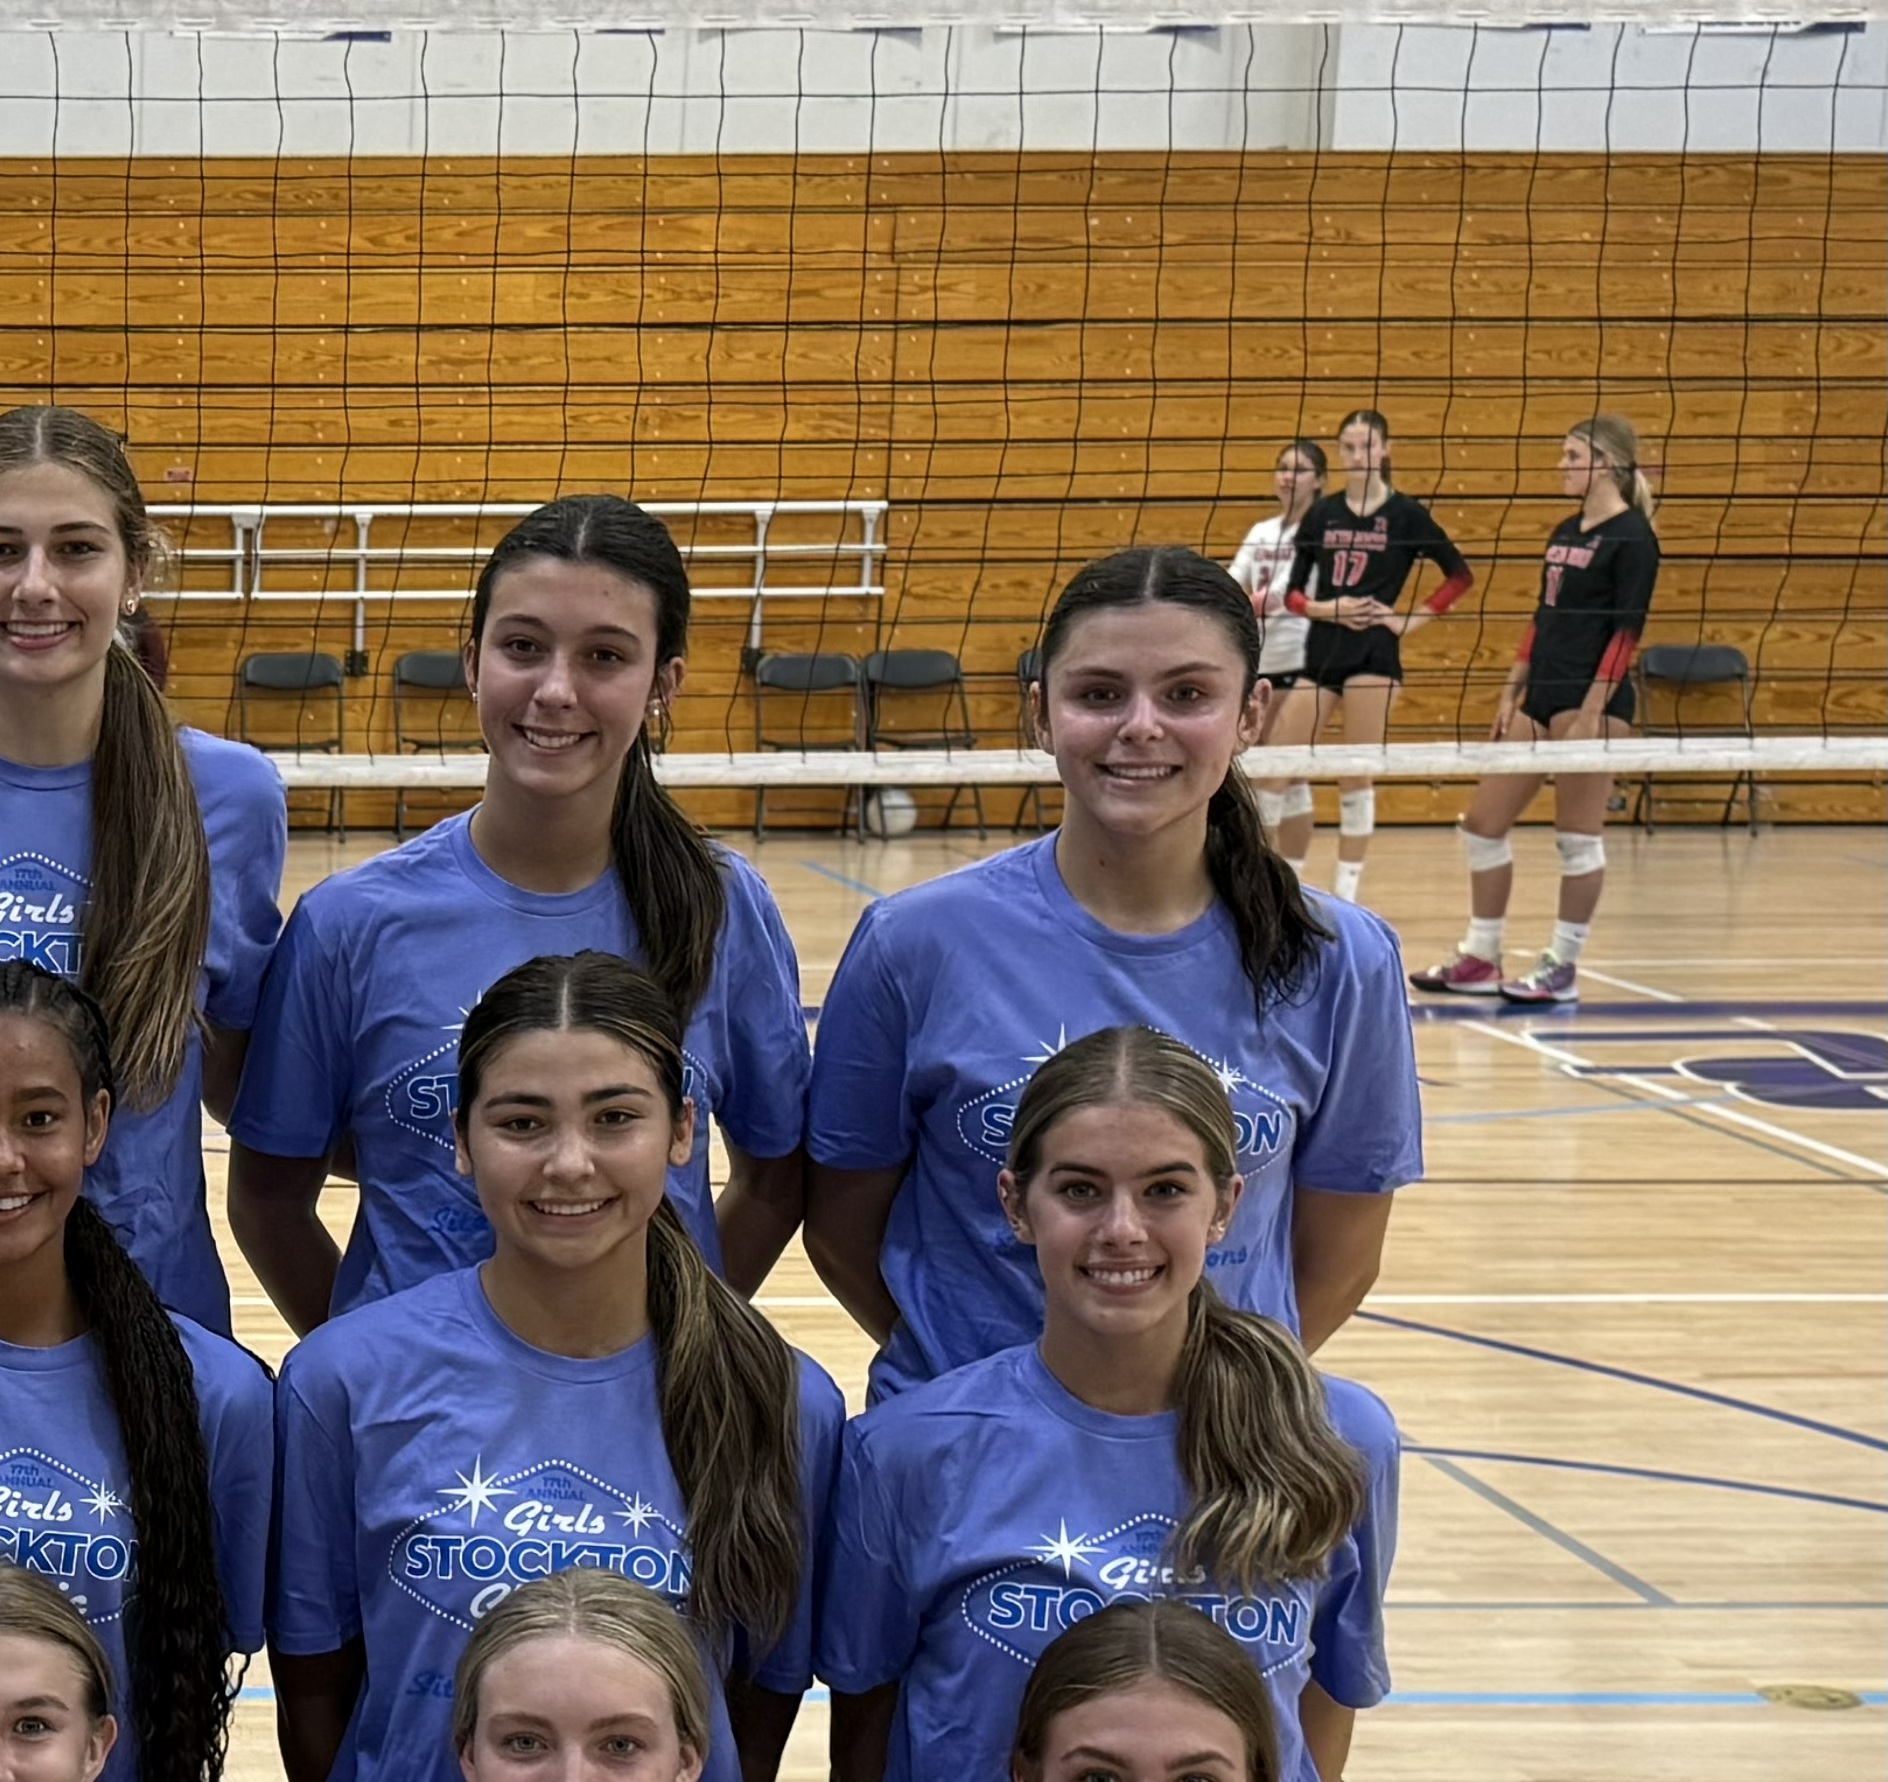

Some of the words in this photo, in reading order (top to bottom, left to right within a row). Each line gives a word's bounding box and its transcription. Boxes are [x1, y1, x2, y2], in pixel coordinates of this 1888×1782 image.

[1331, 550, 1368, 587] 17
[526, 1487, 587, 1501] ANNUAL
[503, 1500, 606, 1537] Girls
[987, 1580, 1302, 1646] STOTON
[407, 1671, 454, 1699] Sit
